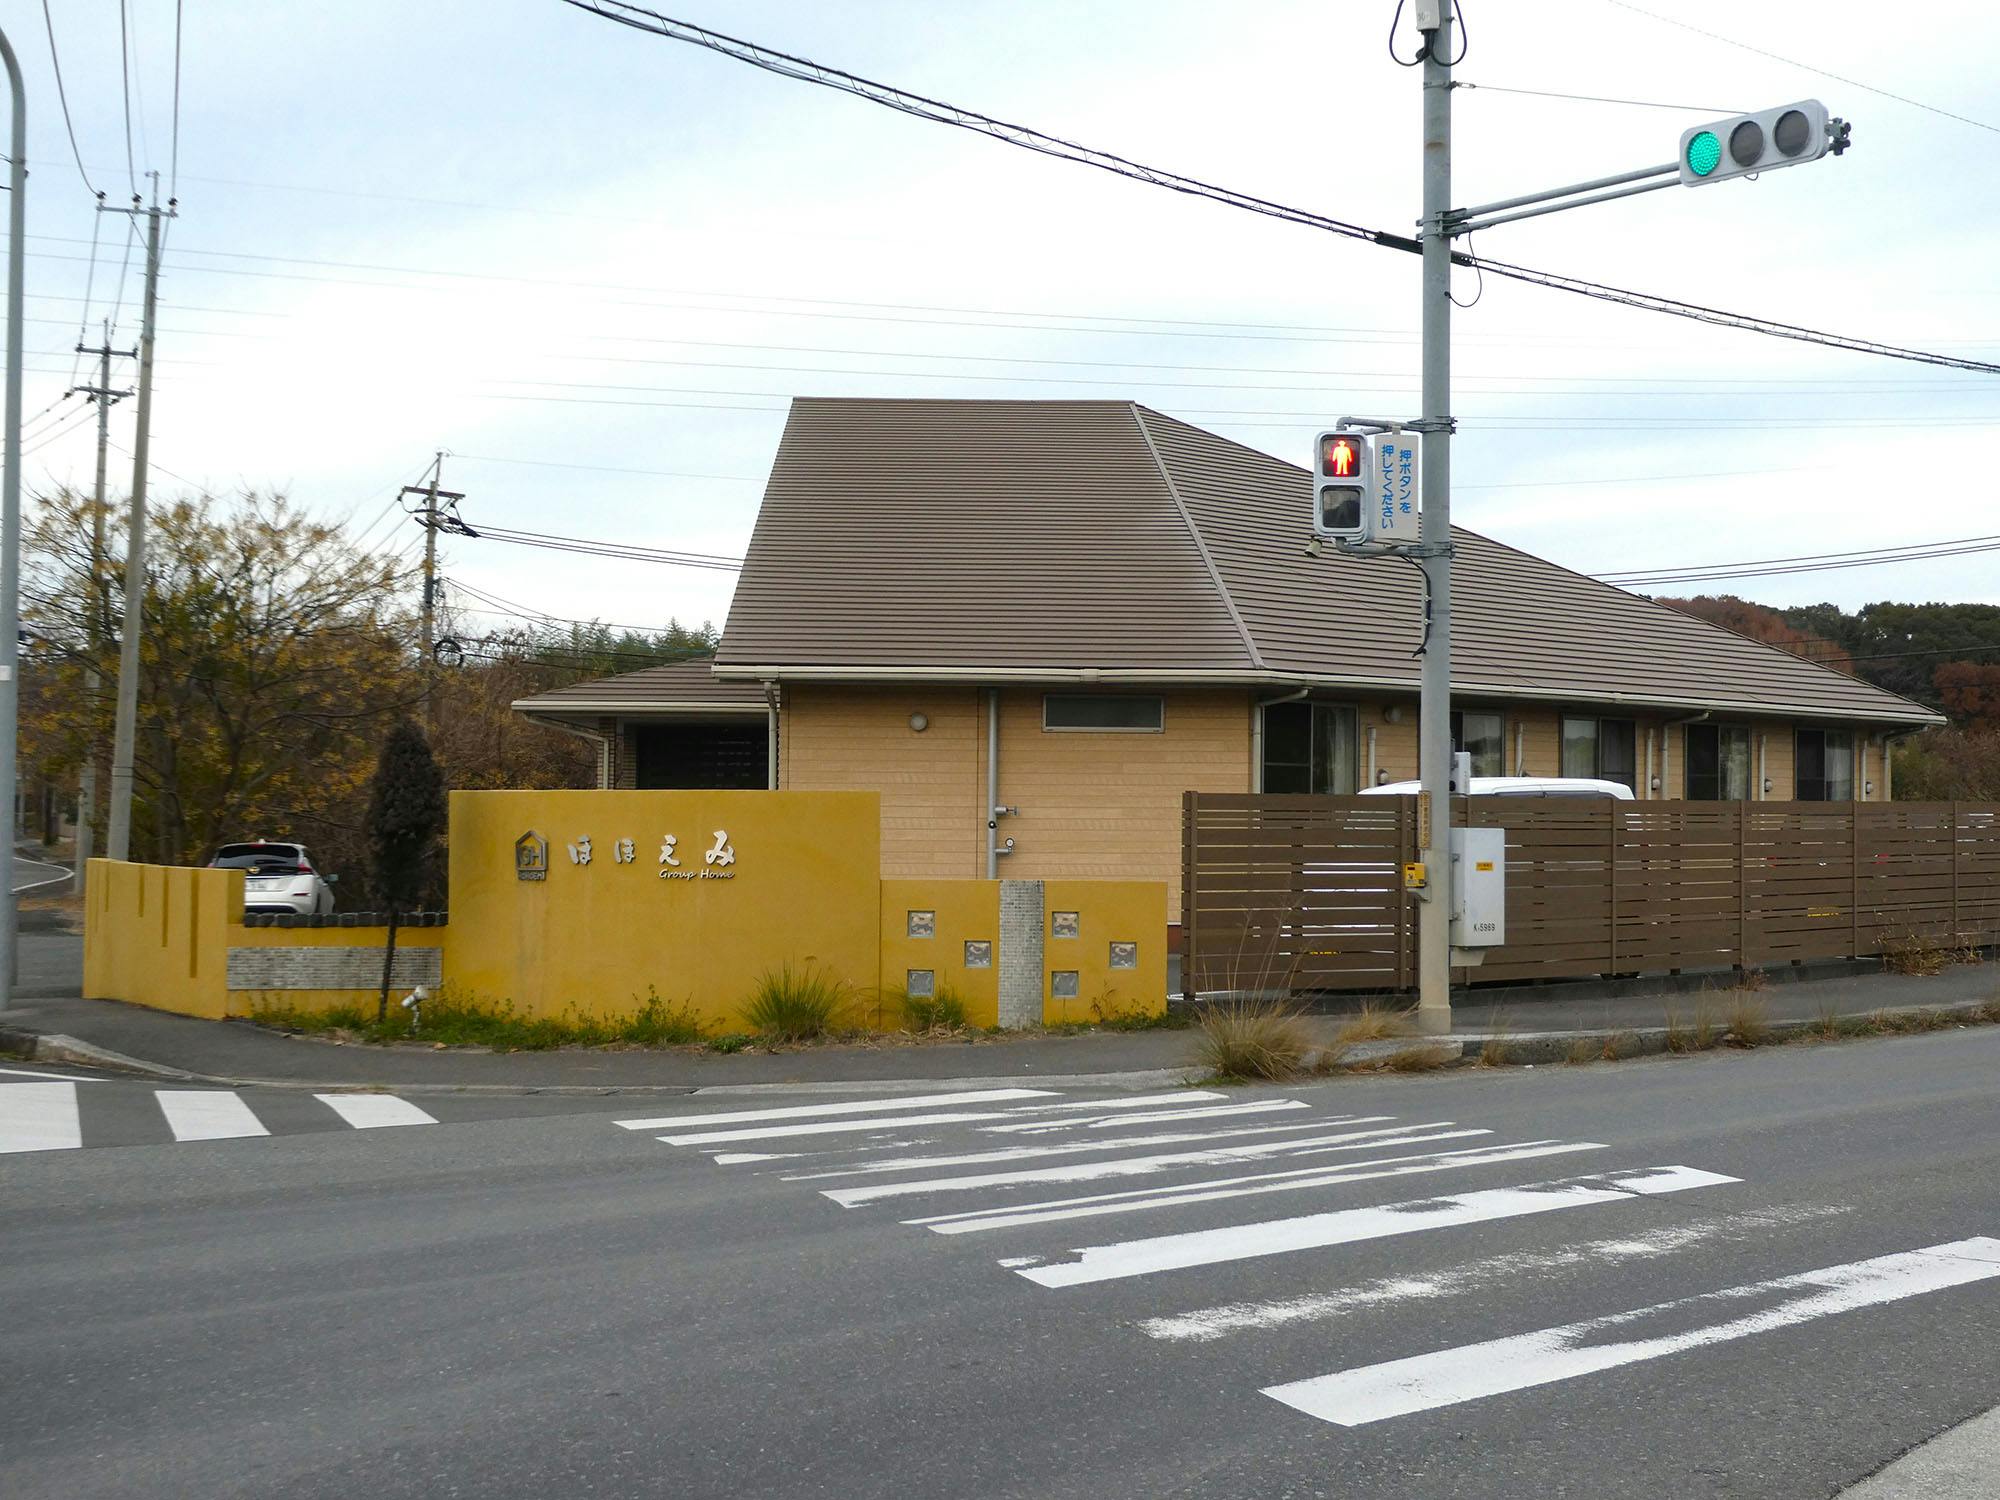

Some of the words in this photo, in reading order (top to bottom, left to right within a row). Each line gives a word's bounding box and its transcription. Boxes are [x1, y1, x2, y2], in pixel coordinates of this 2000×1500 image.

[1382, 444, 1394, 529] 押してください
[1400, 449, 1412, 514] 押ボタンを
[567, 830, 735, 867] ほほえみ
[658, 869, 696, 881] Group
[700, 868, 735, 879] Home
